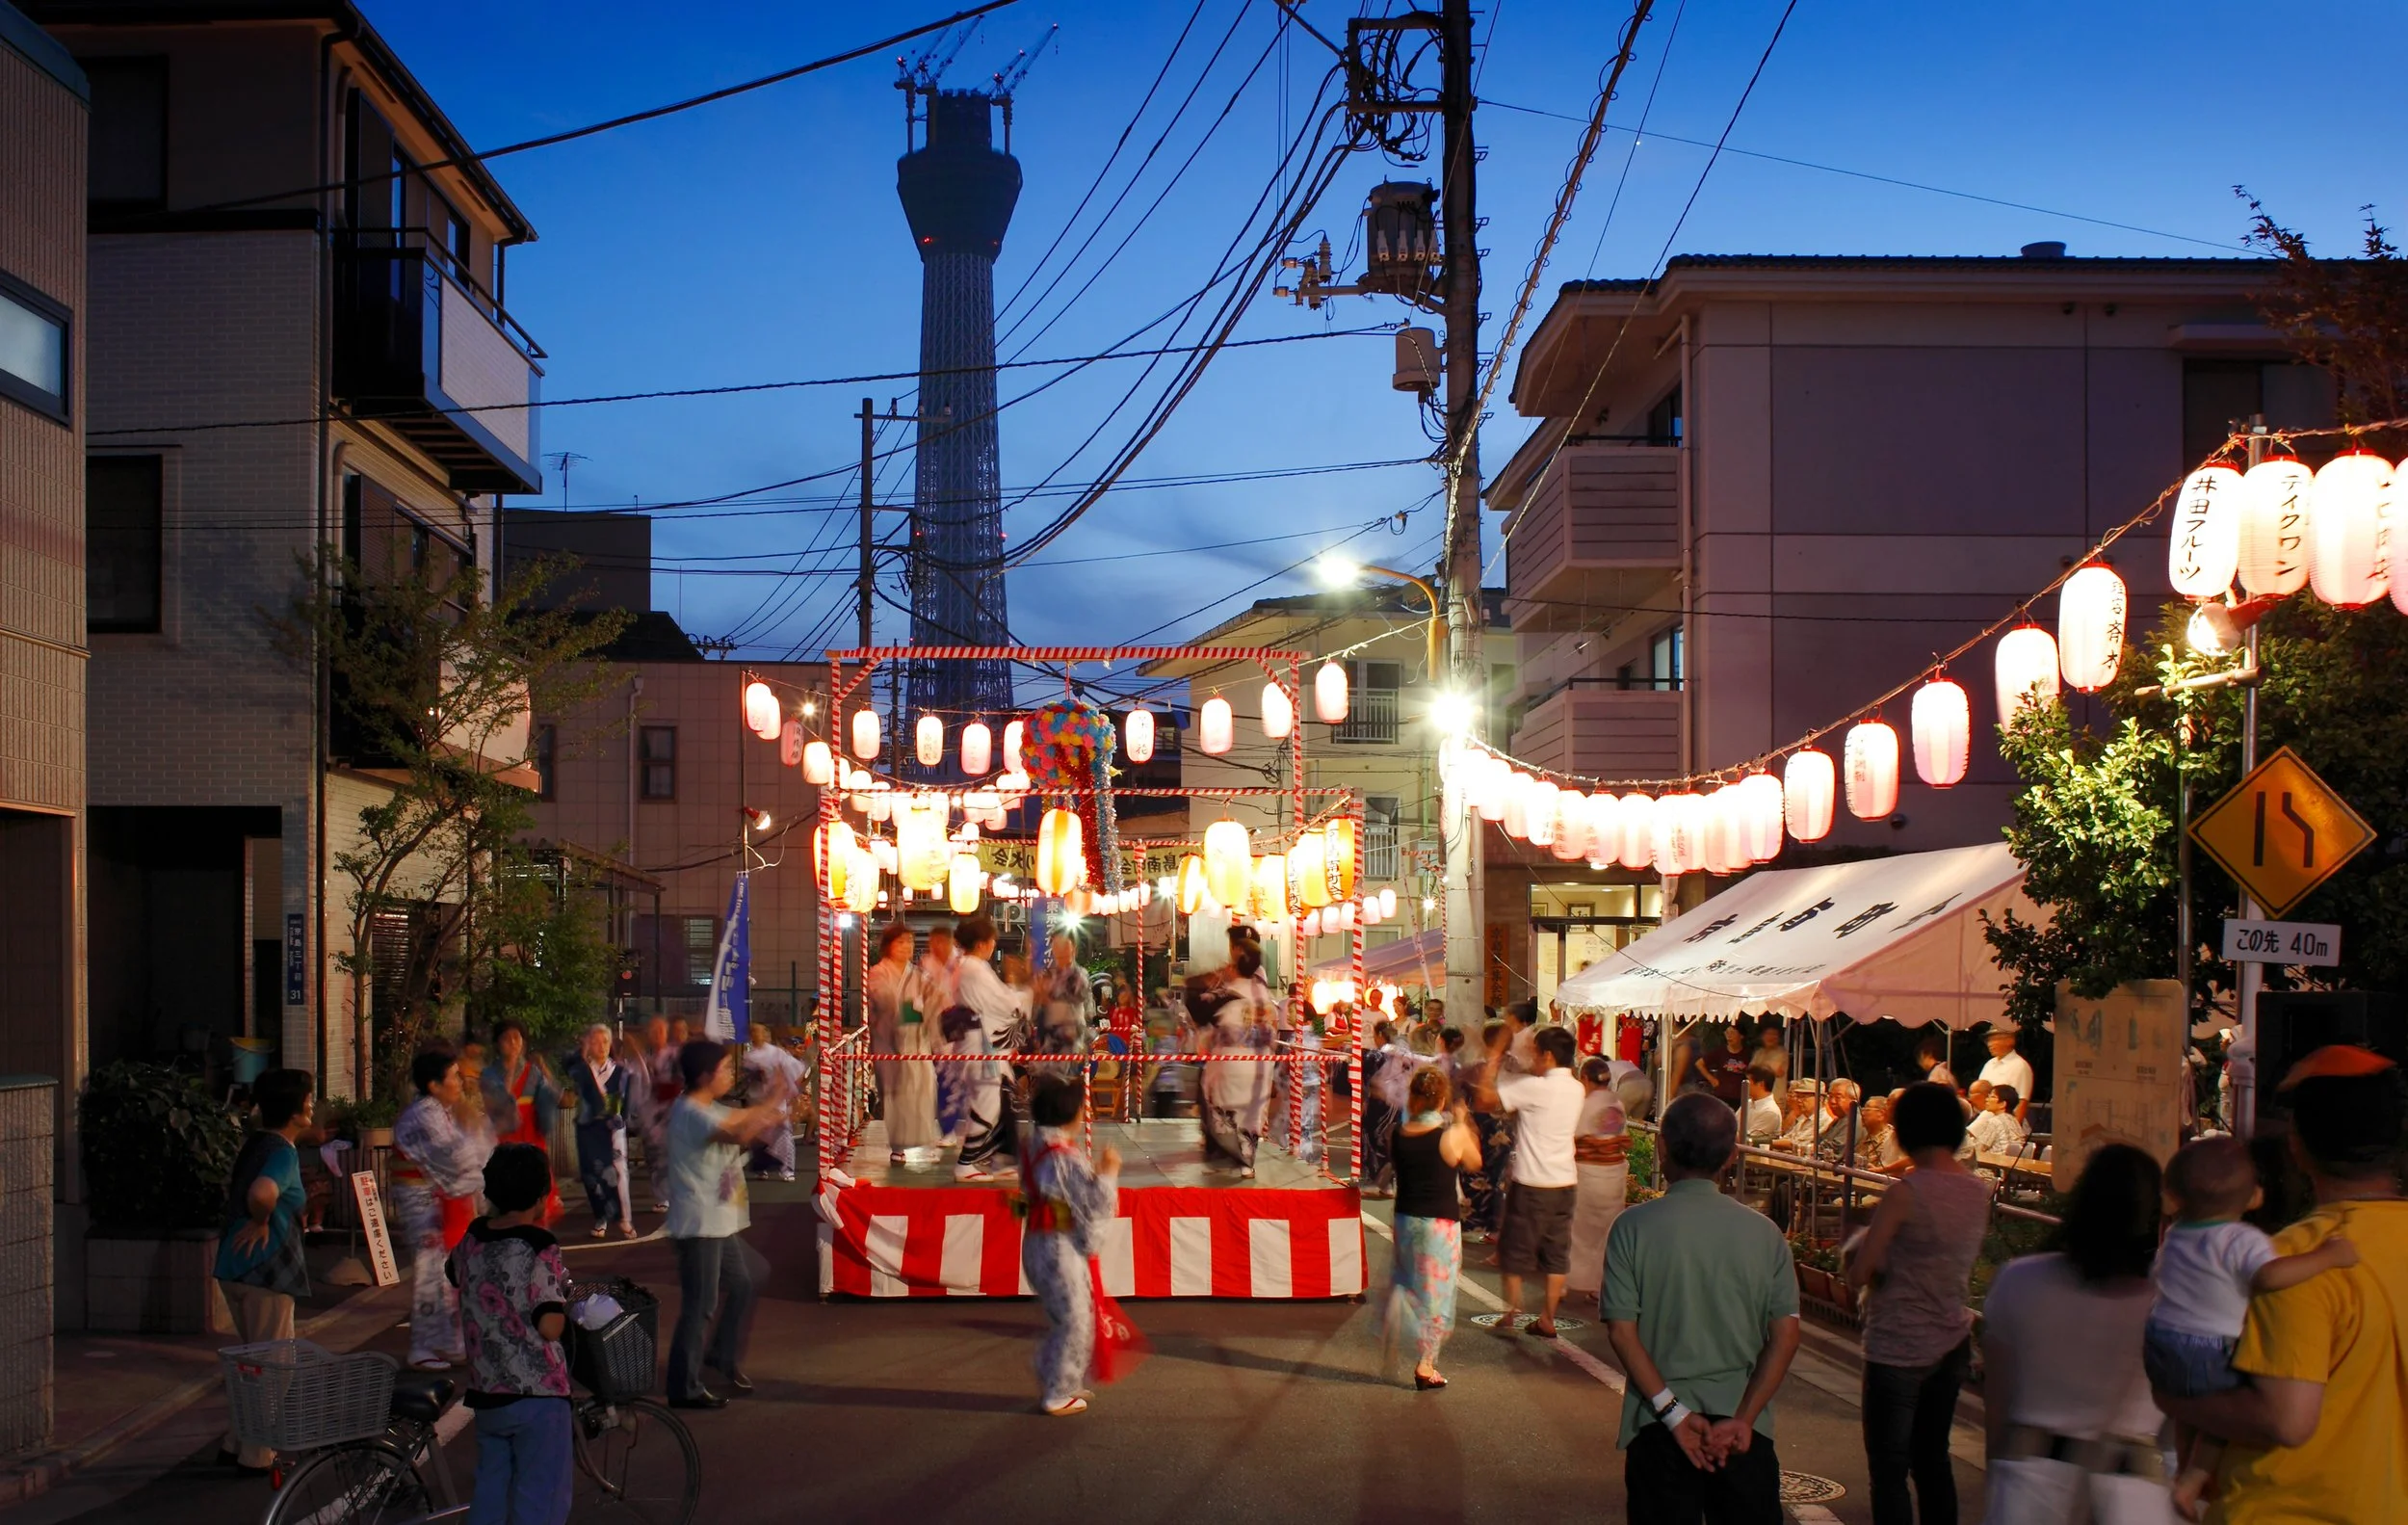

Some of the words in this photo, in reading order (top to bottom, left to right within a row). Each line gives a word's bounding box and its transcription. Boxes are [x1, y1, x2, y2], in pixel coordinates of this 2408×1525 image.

[2179, 475, 2218, 581] 井田フルーツ
[2274, 474, 2303, 576] テイクワン
[2237, 929, 2280, 954] この先
[2290, 932, 2329, 958] 40m
[290, 989, 301, 1000] 31
